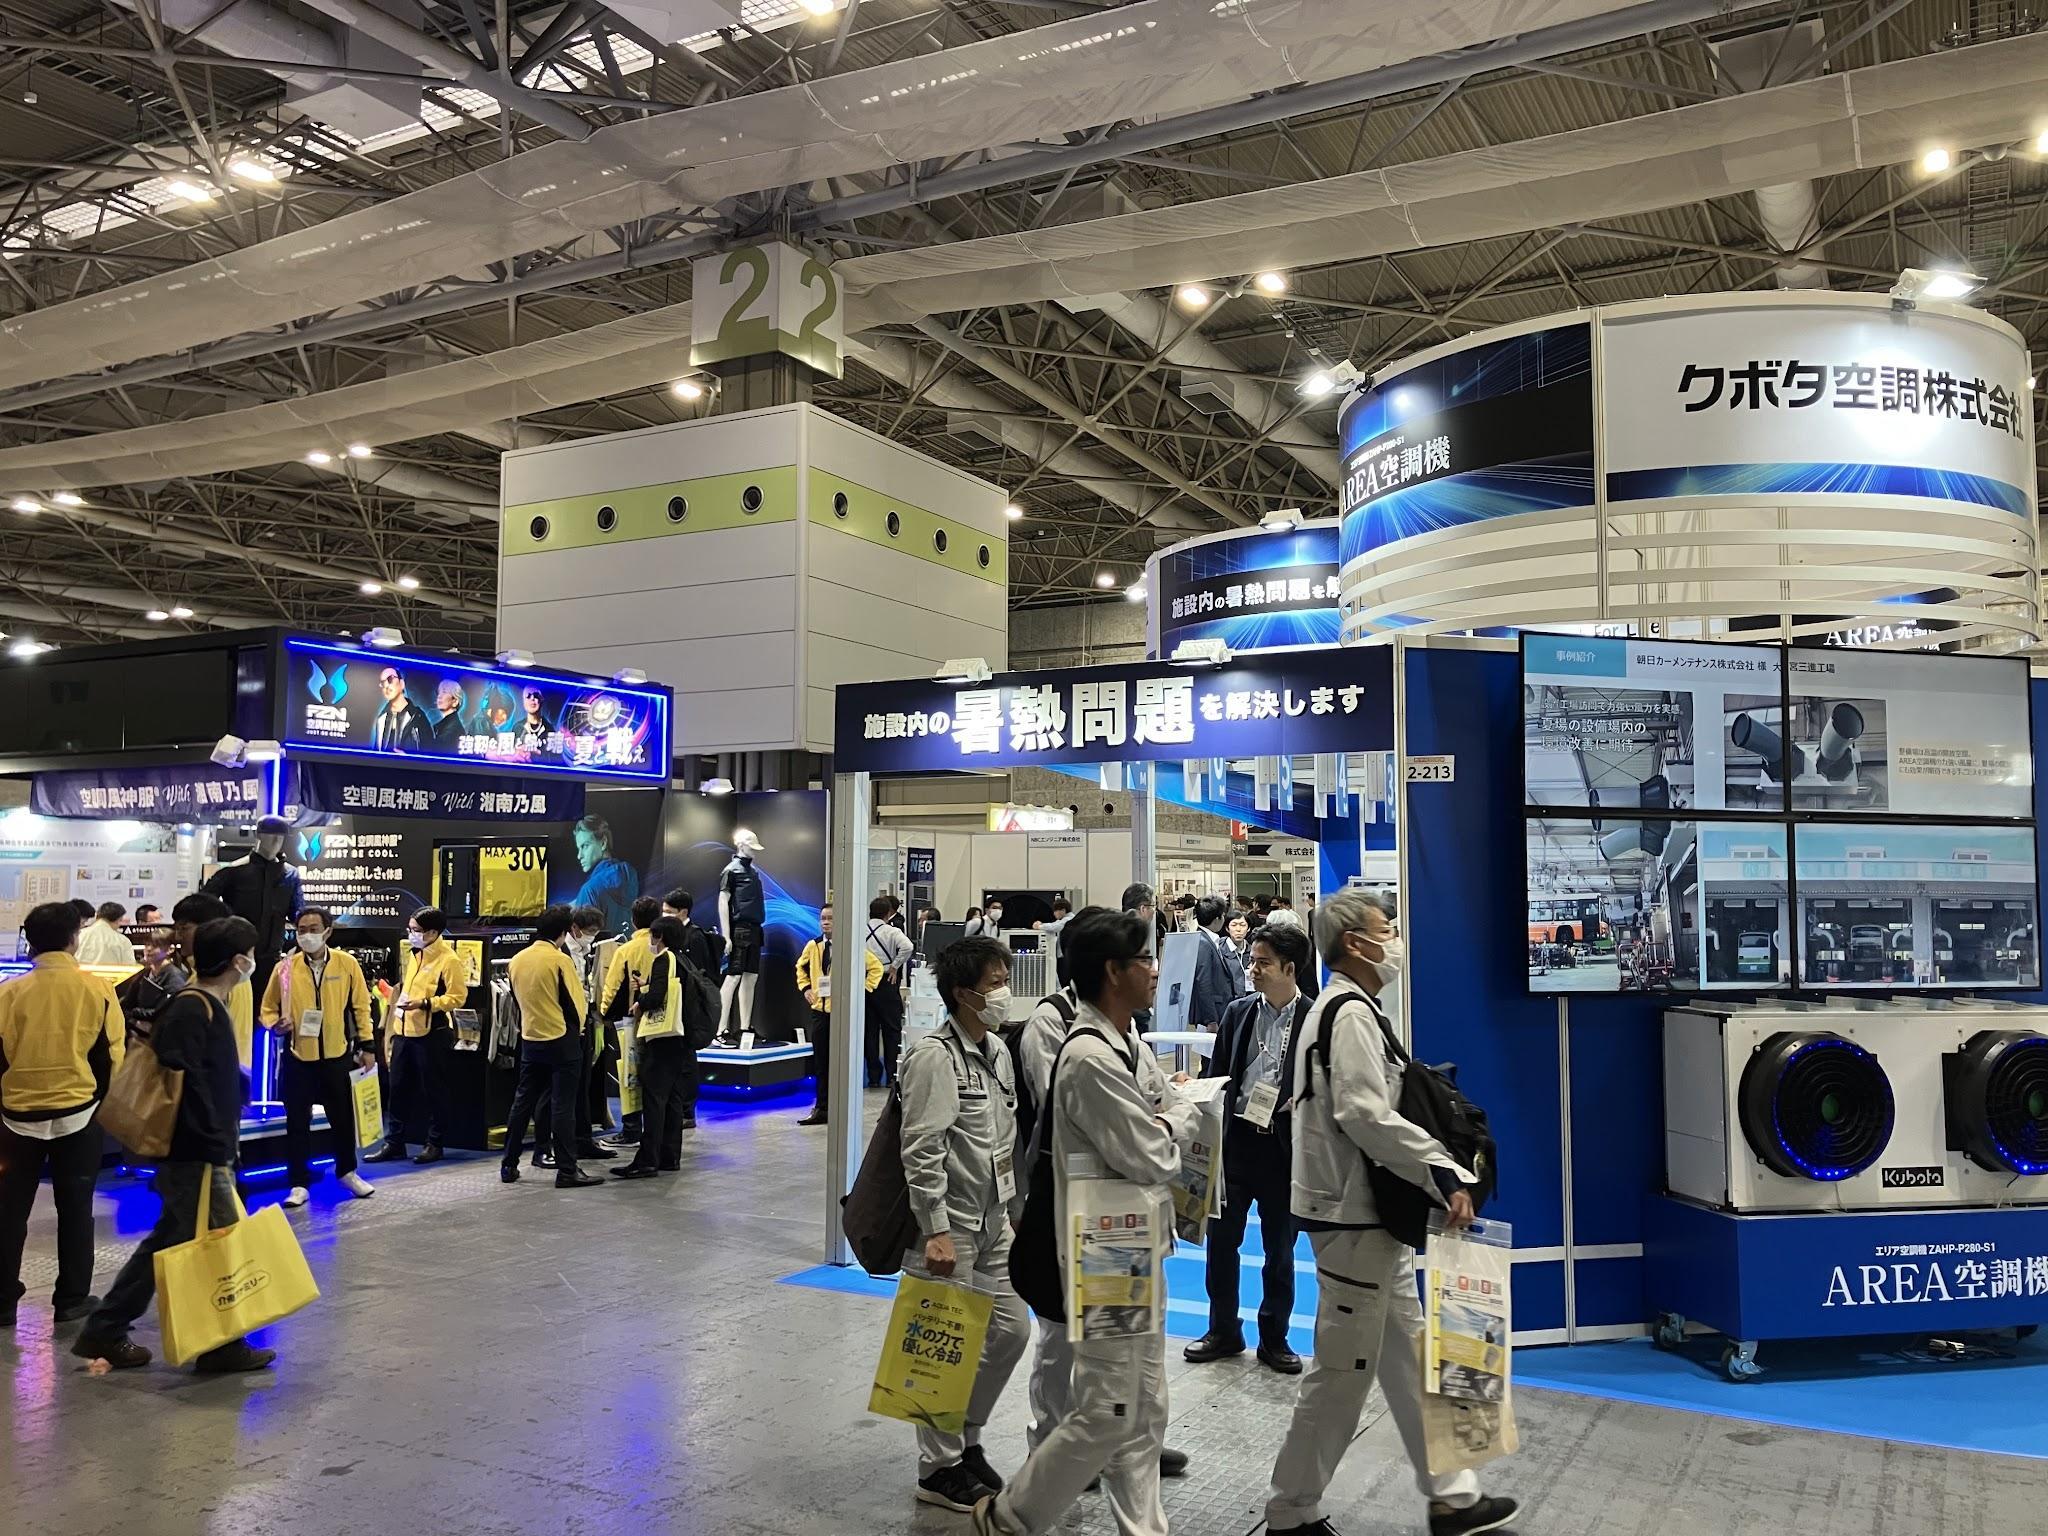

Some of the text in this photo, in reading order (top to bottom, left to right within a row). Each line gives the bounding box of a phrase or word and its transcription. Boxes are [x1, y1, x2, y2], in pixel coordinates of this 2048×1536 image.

[717, 246, 770, 342] 2
[799, 258, 837, 353] 2
[1677, 359, 2025, 441] クボタ空調株式会社
[1556, 650, 1596, 663] 事例紹介
[1636, 654, 1755, 671] 朝日カーメンテナンス株式会社
[1757, 661, 1767, 671] 様
[863, 675, 1366, 755] 施設内の暑熱問題を解決します
[1407, 765, 1451, 779] 2-213
[441, 792, 475, 813] With
[480, 791, 546, 814] 湘南乃風
[484, 846, 547, 872] MAX 30V
[910, 859, 933, 874] NEO
[1884, 1168, 1942, 1186] Kubota
[1875, 1242, 1996, 1256] エリア空調機 ZAHP-P280-S1
[1821, 1255, 2048, 1307] AREA空調機
[905, 1319, 965, 1350] 水の力で
